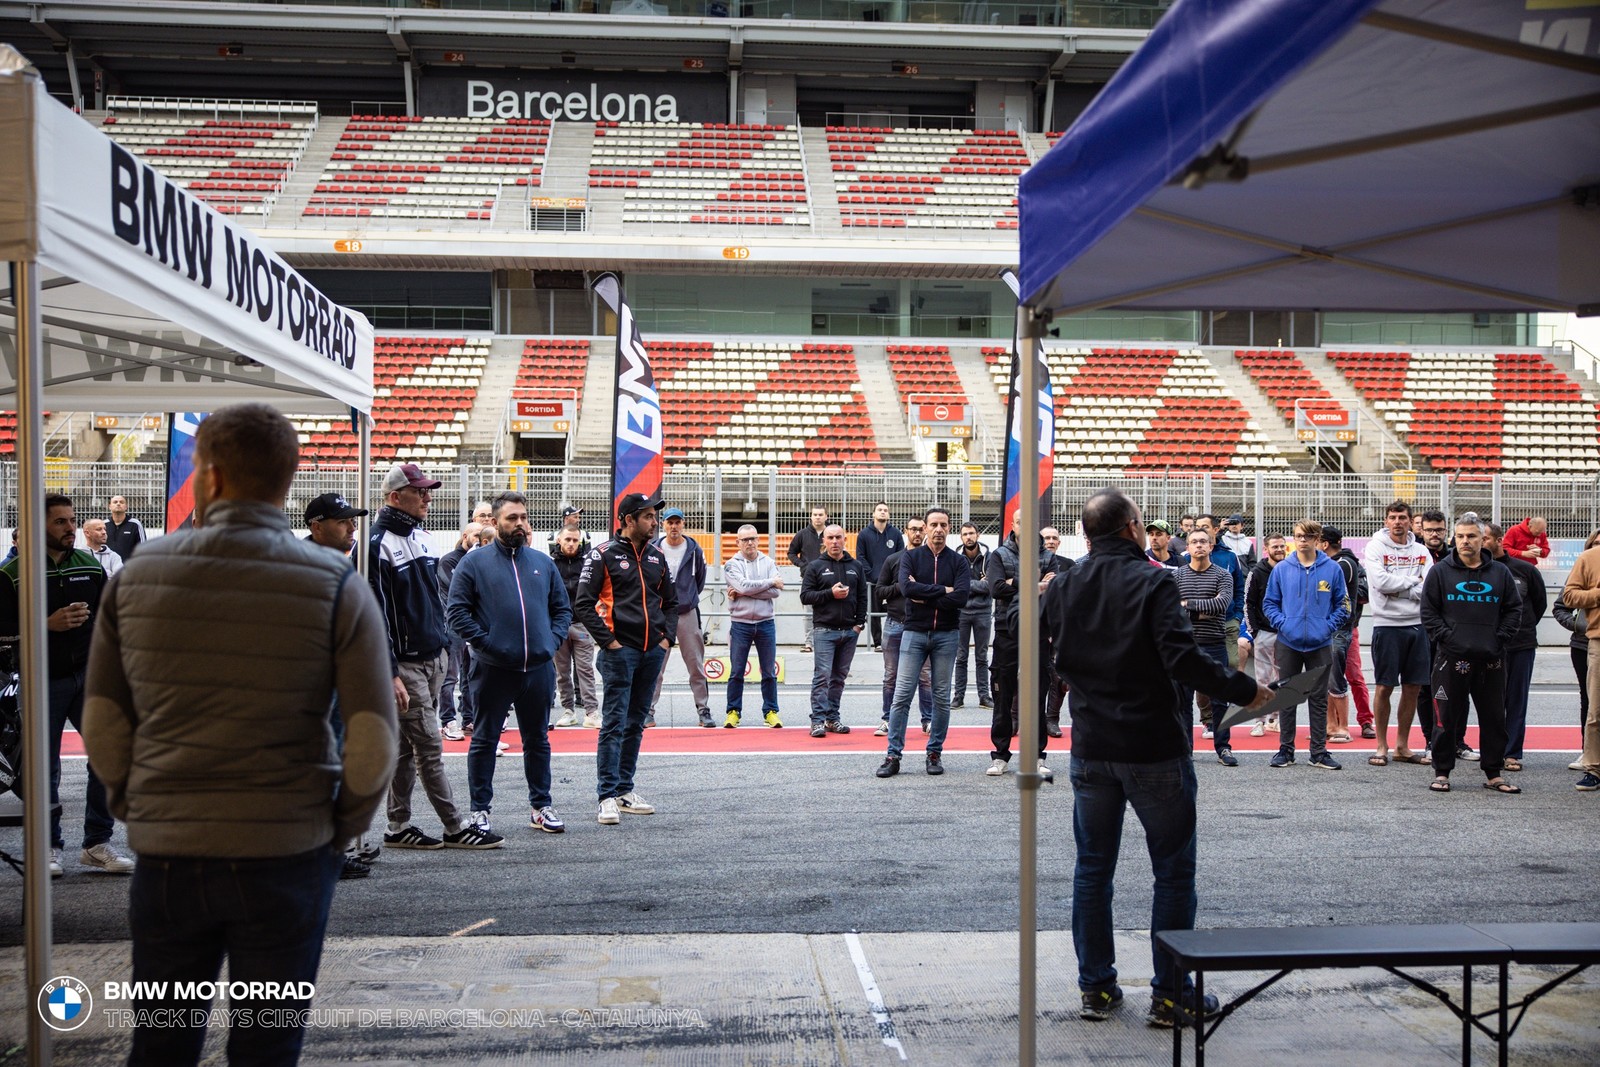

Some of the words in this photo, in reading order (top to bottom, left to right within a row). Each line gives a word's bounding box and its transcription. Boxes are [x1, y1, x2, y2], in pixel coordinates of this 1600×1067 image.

[452, 53, 464, 62] 24
[691, 59, 703, 68] 25
[906, 66, 918, 74] 26
[467, 80, 679, 122] Barcelona
[345, 241, 360, 252] 18
[110, 141, 213, 290] BMW
[224, 225, 357, 371] MOTORRAD
[733, 248, 748, 258] 19
[104, 417, 116, 426] 17
[519, 422, 530, 430] 18
[557, 422, 568, 430] 19
[953, 427, 965, 435] 20
[1303, 431, 1314, 439] 20
[1338, 431, 1349, 439] 21
[1447, 593, 1499, 603] OAKLEY
